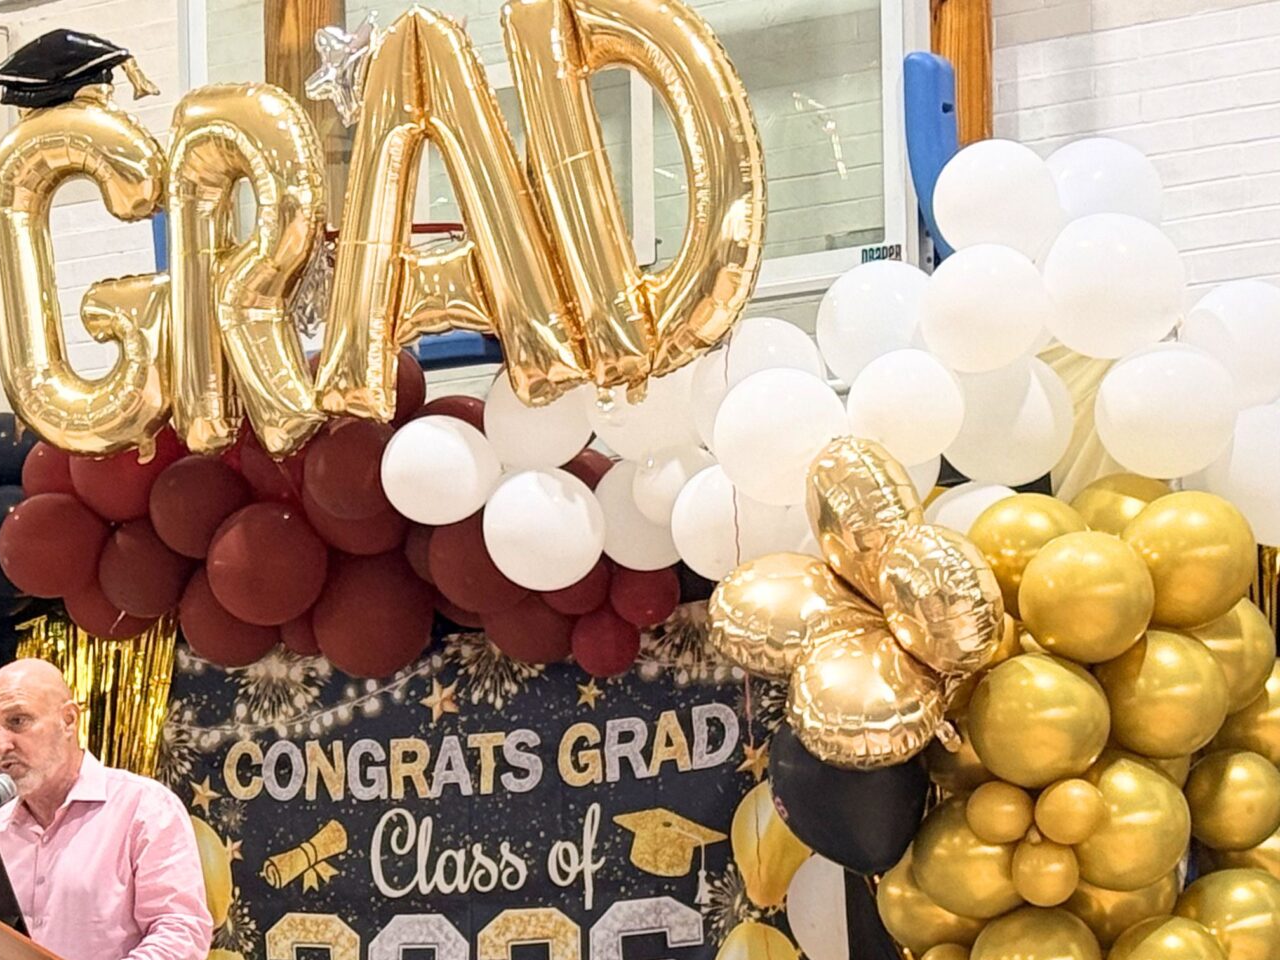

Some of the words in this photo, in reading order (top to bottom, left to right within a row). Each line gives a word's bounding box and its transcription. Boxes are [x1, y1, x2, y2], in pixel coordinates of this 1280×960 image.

[223, 729, 544, 801] CONGRATS
[558, 702, 739, 787] GRAD
[370, 807, 528, 898] Class
[547, 802, 606, 911] of
